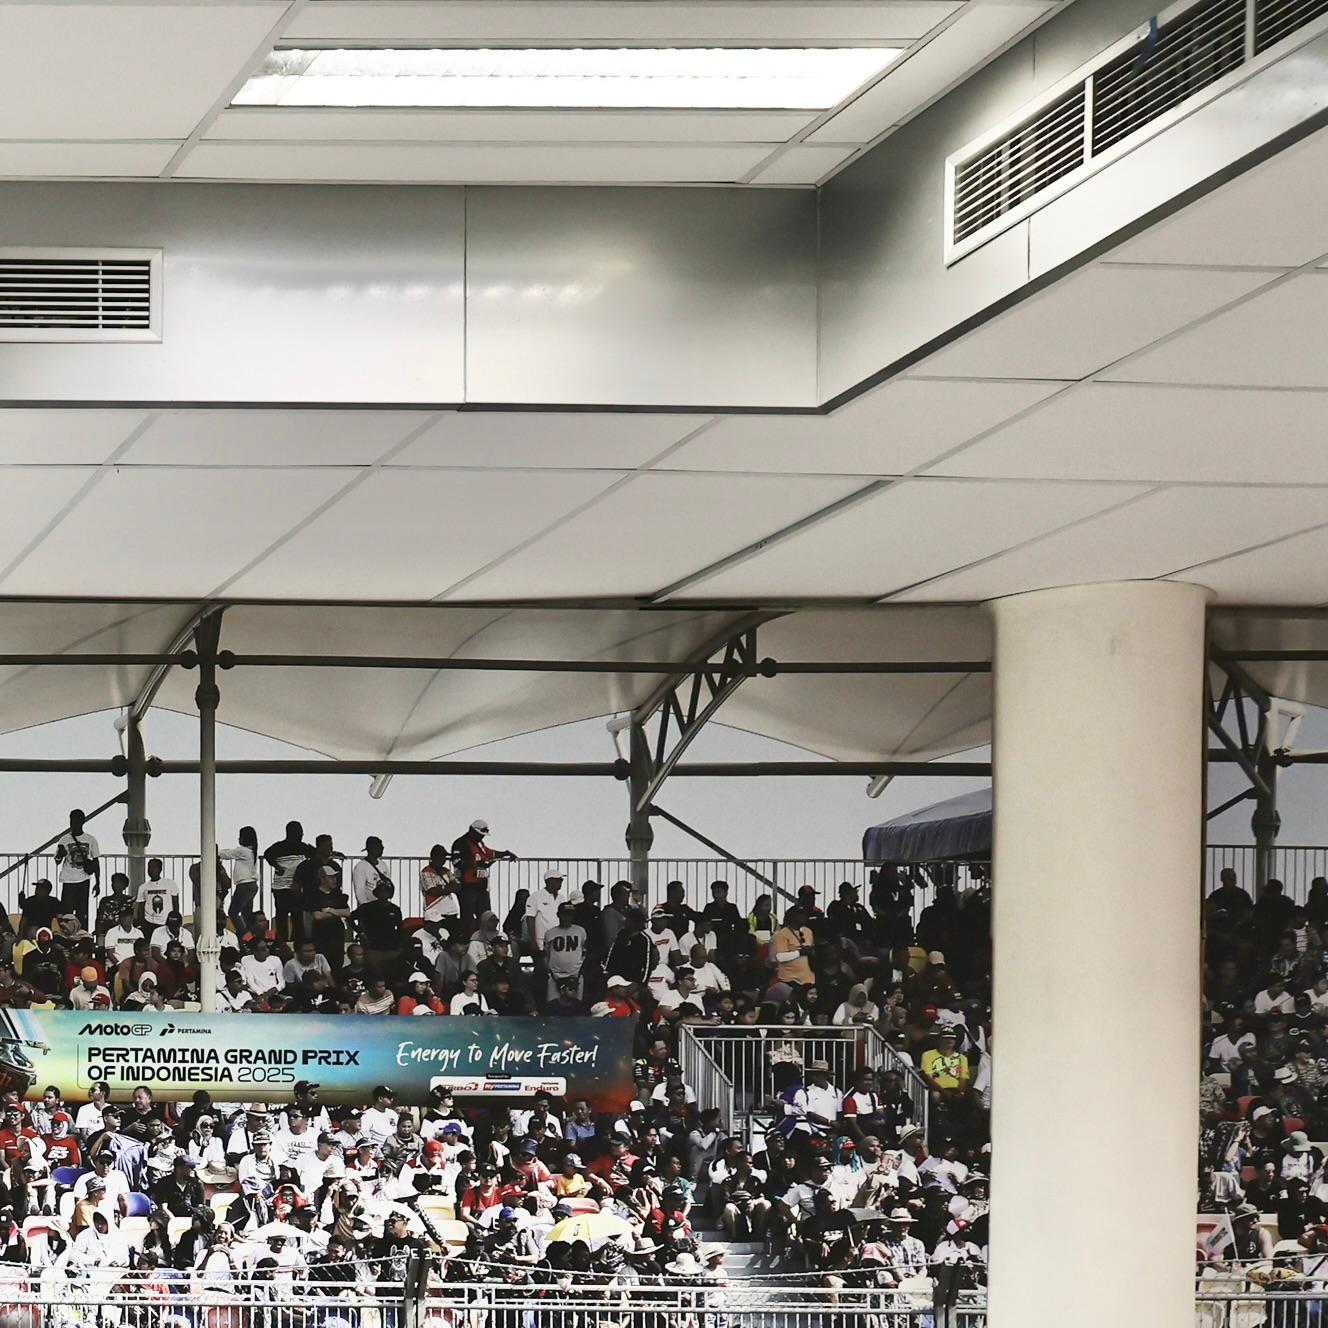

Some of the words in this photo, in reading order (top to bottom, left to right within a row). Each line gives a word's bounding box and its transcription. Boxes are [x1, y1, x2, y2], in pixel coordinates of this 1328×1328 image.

[553, 935, 579, 952] ON
[78, 1023, 152, 1037] MotoGP
[87, 1047, 220, 1065] PERTAMINA
[224, 1049, 298, 1066] GRAND
[302, 1050, 360, 1066] PRIX
[396, 1041, 461, 1072] Energy
[467, 1043, 483, 1064] to
[489, 1042, 533, 1071] Move
[537, 1042, 599, 1068] Faster!
[87, 1065, 116, 1081] OF
[120, 1066, 234, 1082] INDONESIA
[237, 1067, 296, 1083] 2025
